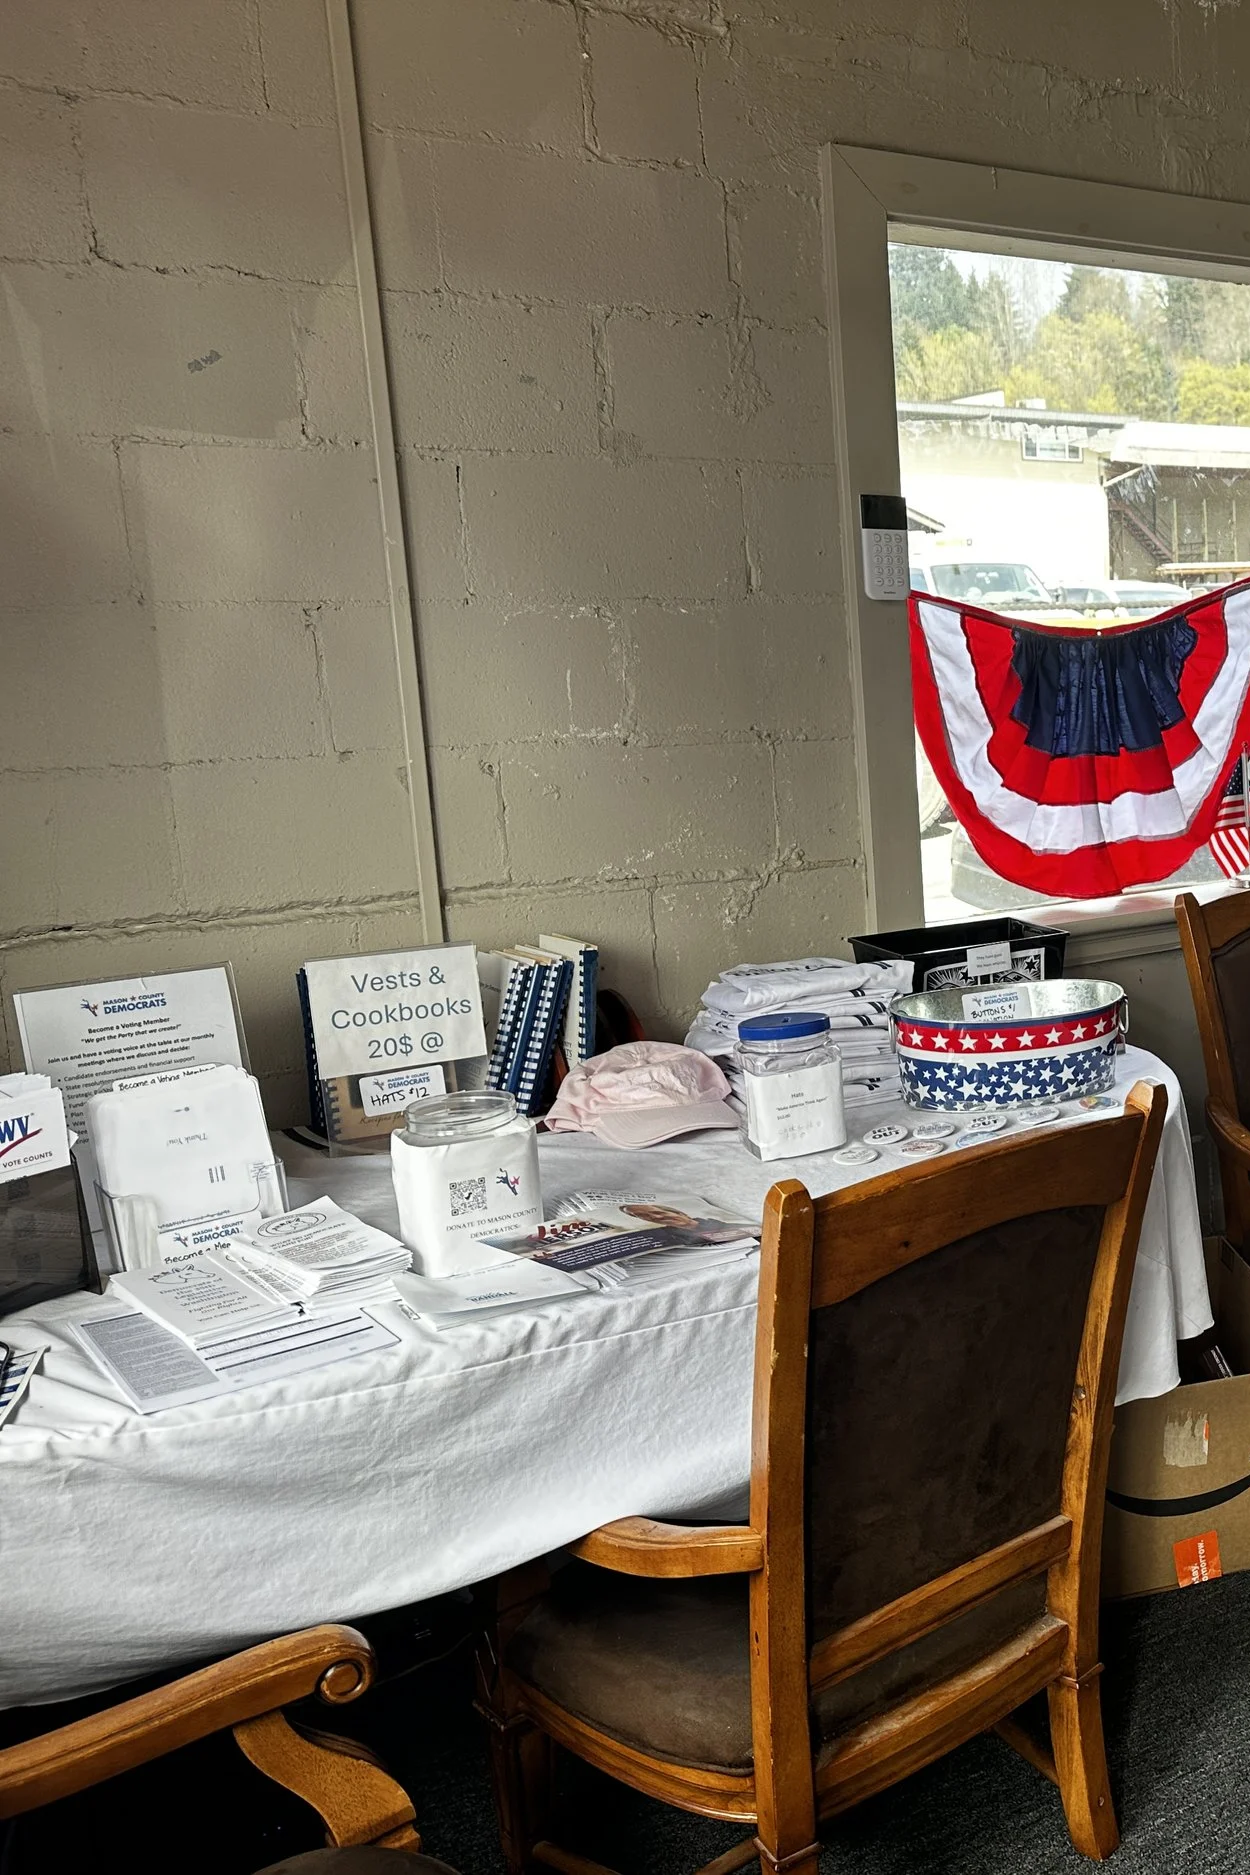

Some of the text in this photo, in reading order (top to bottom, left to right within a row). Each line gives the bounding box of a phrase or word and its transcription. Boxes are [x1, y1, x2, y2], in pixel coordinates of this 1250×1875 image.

[351, 966, 446, 993] Vests &
[103, 992, 165, 1005] MASON COUNTY
[104, 998, 167, 1015] DEMOCRATS
[984, 996, 1018, 1005] DEMOCRATS
[331, 998, 472, 1030] Cookbooks
[971, 1006, 1005, 1019] BUTTONS
[88, 1025, 114, 1034] Become
[121, 1021, 142, 1029] Voting
[143, 1018, 170, 1026] Member
[47, 1054, 60, 1064] Join
[82, 1050, 97, 1058] have
[103, 1047, 122, 1055] voting
[158, 1039, 172, 1047] table
[191, 1033, 214, 1041] monthly
[368, 1031, 444, 1059] 20$ @
[78, 1059, 105, 1068] meetings
[169, 1045, 190, 1053] decide:
[63, 1055, 195, 1082] Candidate endorsements and financial support
[118, 1074, 149, 1091] Become
[388, 1076, 430, 1089] DEMOCRATS
[67, 1092, 93, 1100] Strategic
[370, 1087, 430, 1106] HATS $12
[872, 1126, 897, 1134] ICE
[971, 1119, 998, 1128] OUT
[872, 1130, 900, 1139] OUT
[3, 1151, 53, 1168] VOTE COUNTS
[446, 1220, 474, 1231] DONATE
[487, 1214, 511, 1223] MASON
[512, 1207, 537, 1219] COUNTY
[192, 1220, 243, 1236] MASON COUNTY
[164, 1249, 203, 1264] Become
[1197, 1540, 1208, 1581] omorrow.
